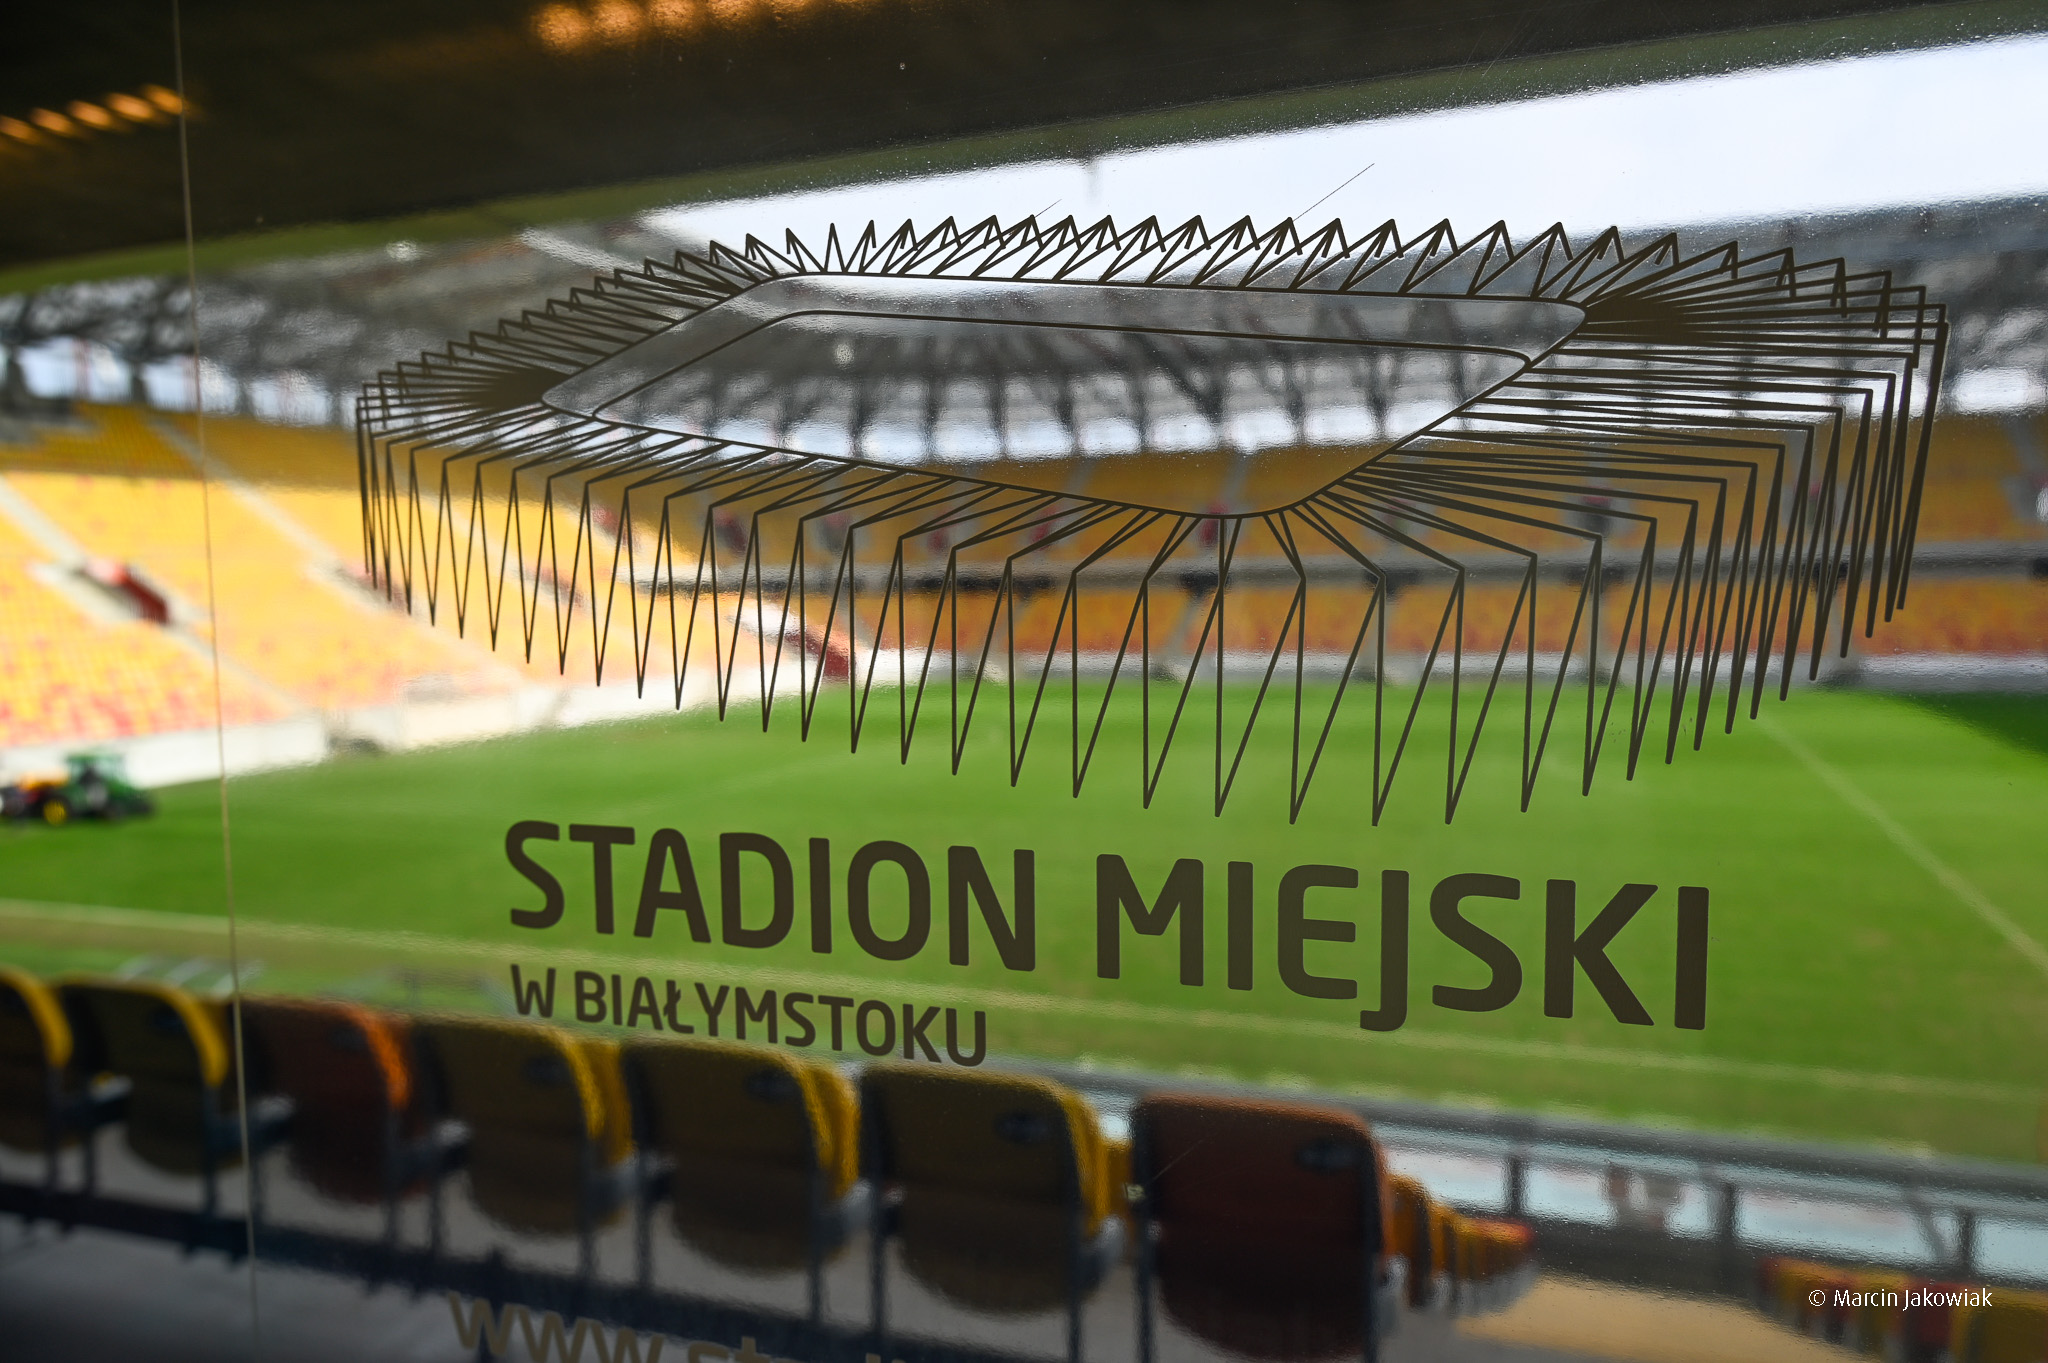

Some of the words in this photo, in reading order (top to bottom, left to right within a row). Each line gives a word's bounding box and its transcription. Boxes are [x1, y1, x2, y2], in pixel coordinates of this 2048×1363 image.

[505, 820, 1036, 971] STADION
[1096, 854, 1710, 1032] MIEJSKI
[510, 963, 556, 1018] W
[574, 970, 987, 1067] BIAŁYMSTOKU
